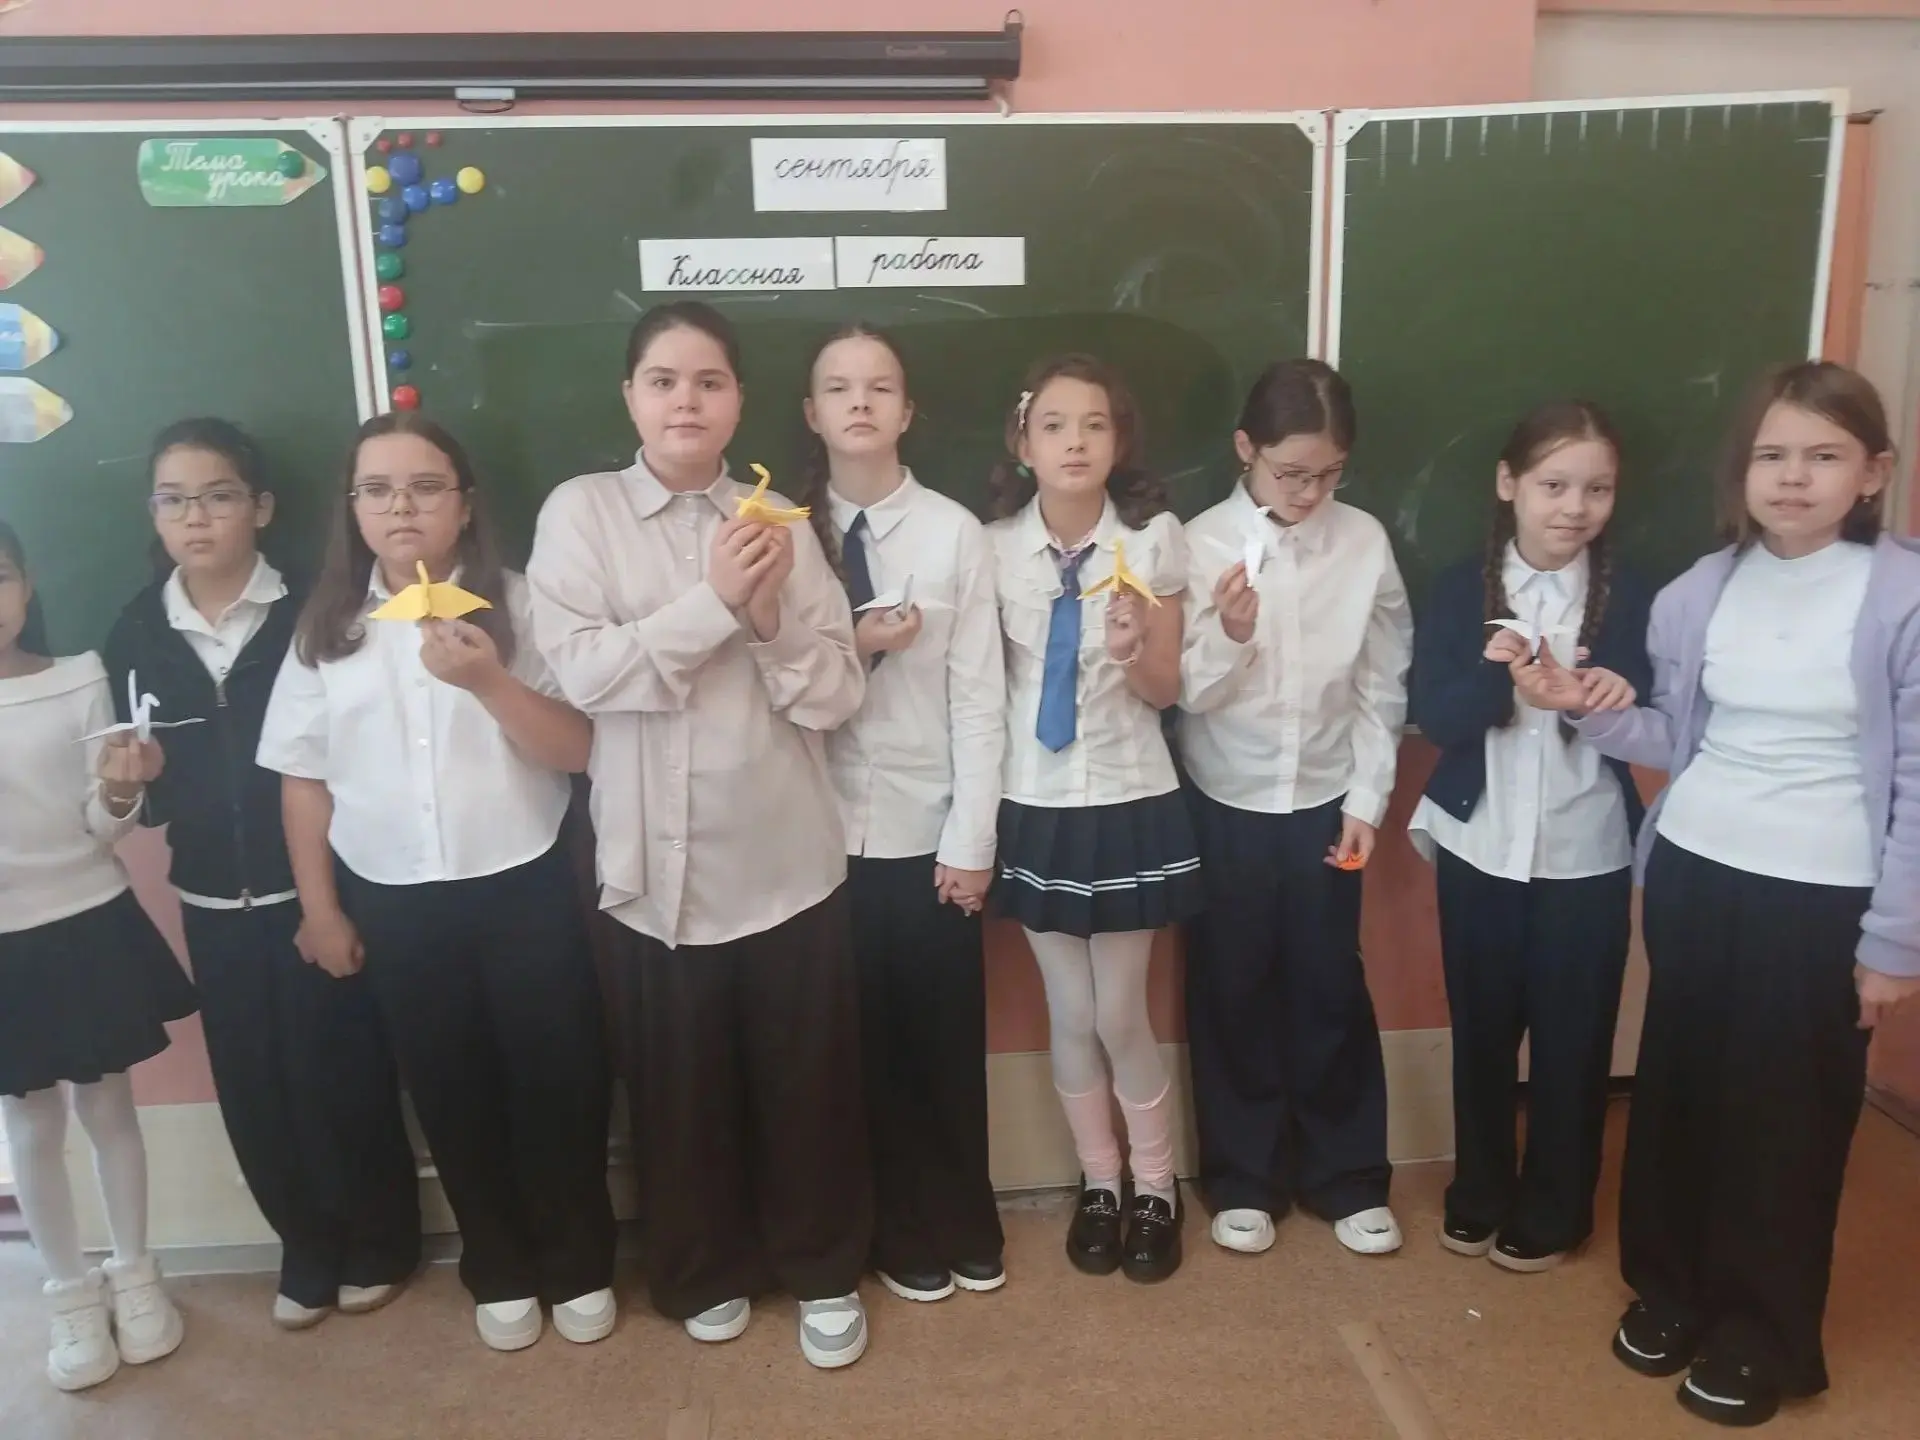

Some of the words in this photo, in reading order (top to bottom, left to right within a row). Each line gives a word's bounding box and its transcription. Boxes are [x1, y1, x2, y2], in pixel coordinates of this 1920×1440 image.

[160, 142, 248, 171] Тема
[773, 139, 935, 195] сентября
[207, 169, 285, 200] урока
[667, 255, 805, 286] Классная
[867, 238, 984, 284] работа
